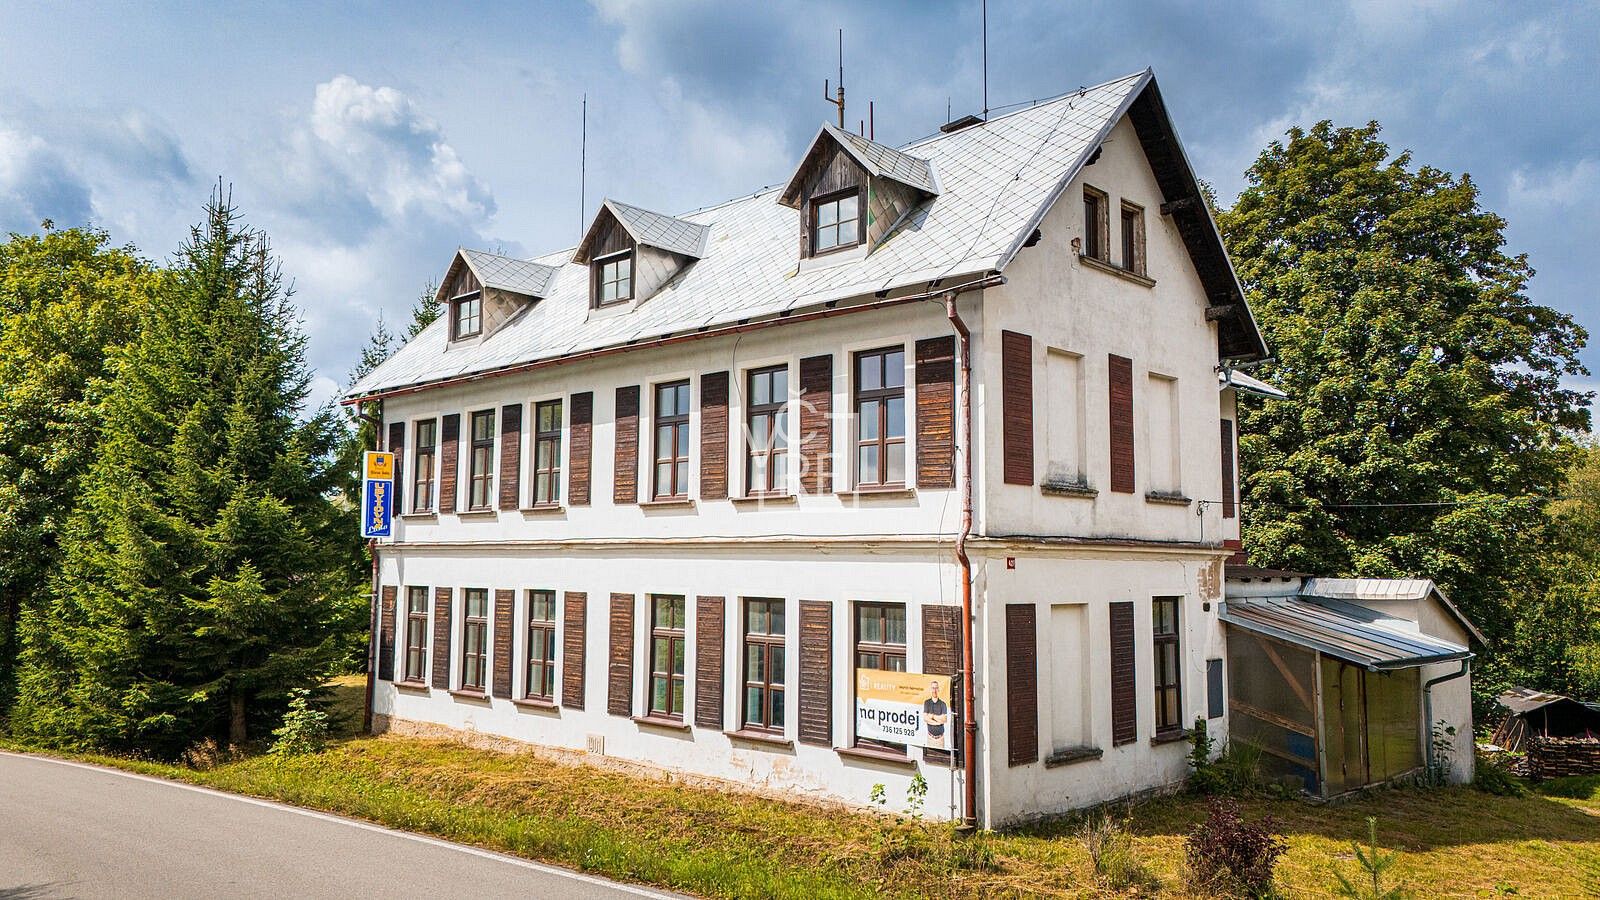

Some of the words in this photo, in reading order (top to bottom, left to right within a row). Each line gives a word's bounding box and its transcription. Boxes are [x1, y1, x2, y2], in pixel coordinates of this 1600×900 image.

[860, 707, 875, 719] na
[878, 710, 919, 731] prodej
[893, 727, 903, 735] 125
[903, 728, 915, 737] 928
